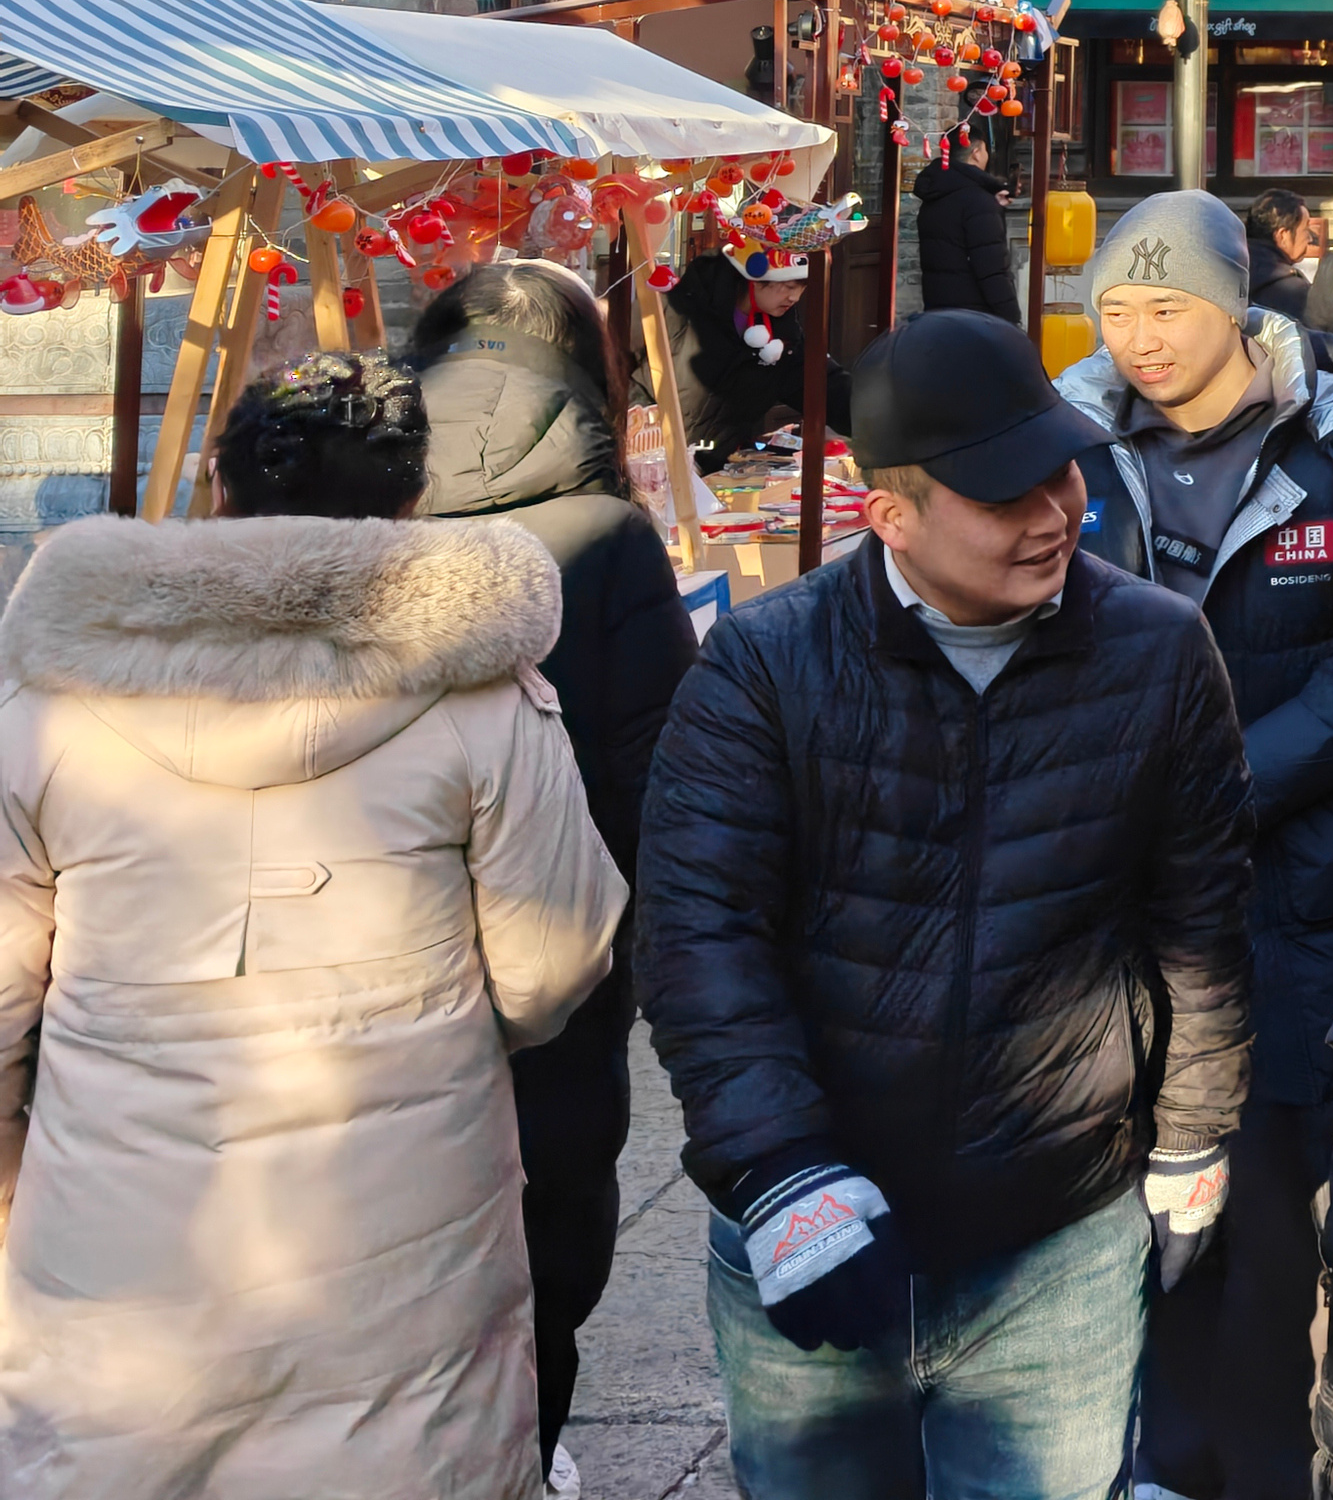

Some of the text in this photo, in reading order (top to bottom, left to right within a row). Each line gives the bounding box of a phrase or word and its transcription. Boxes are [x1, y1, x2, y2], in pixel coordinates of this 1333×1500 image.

[1127, 237, 1172, 280] NY
[1277, 525, 1325, 549] 中国
[1274, 549, 1328, 562] CHINA
[1270, 573, 1332, 586] BOSIDENG
[779, 1222, 861, 1276] MOUNTAINS
